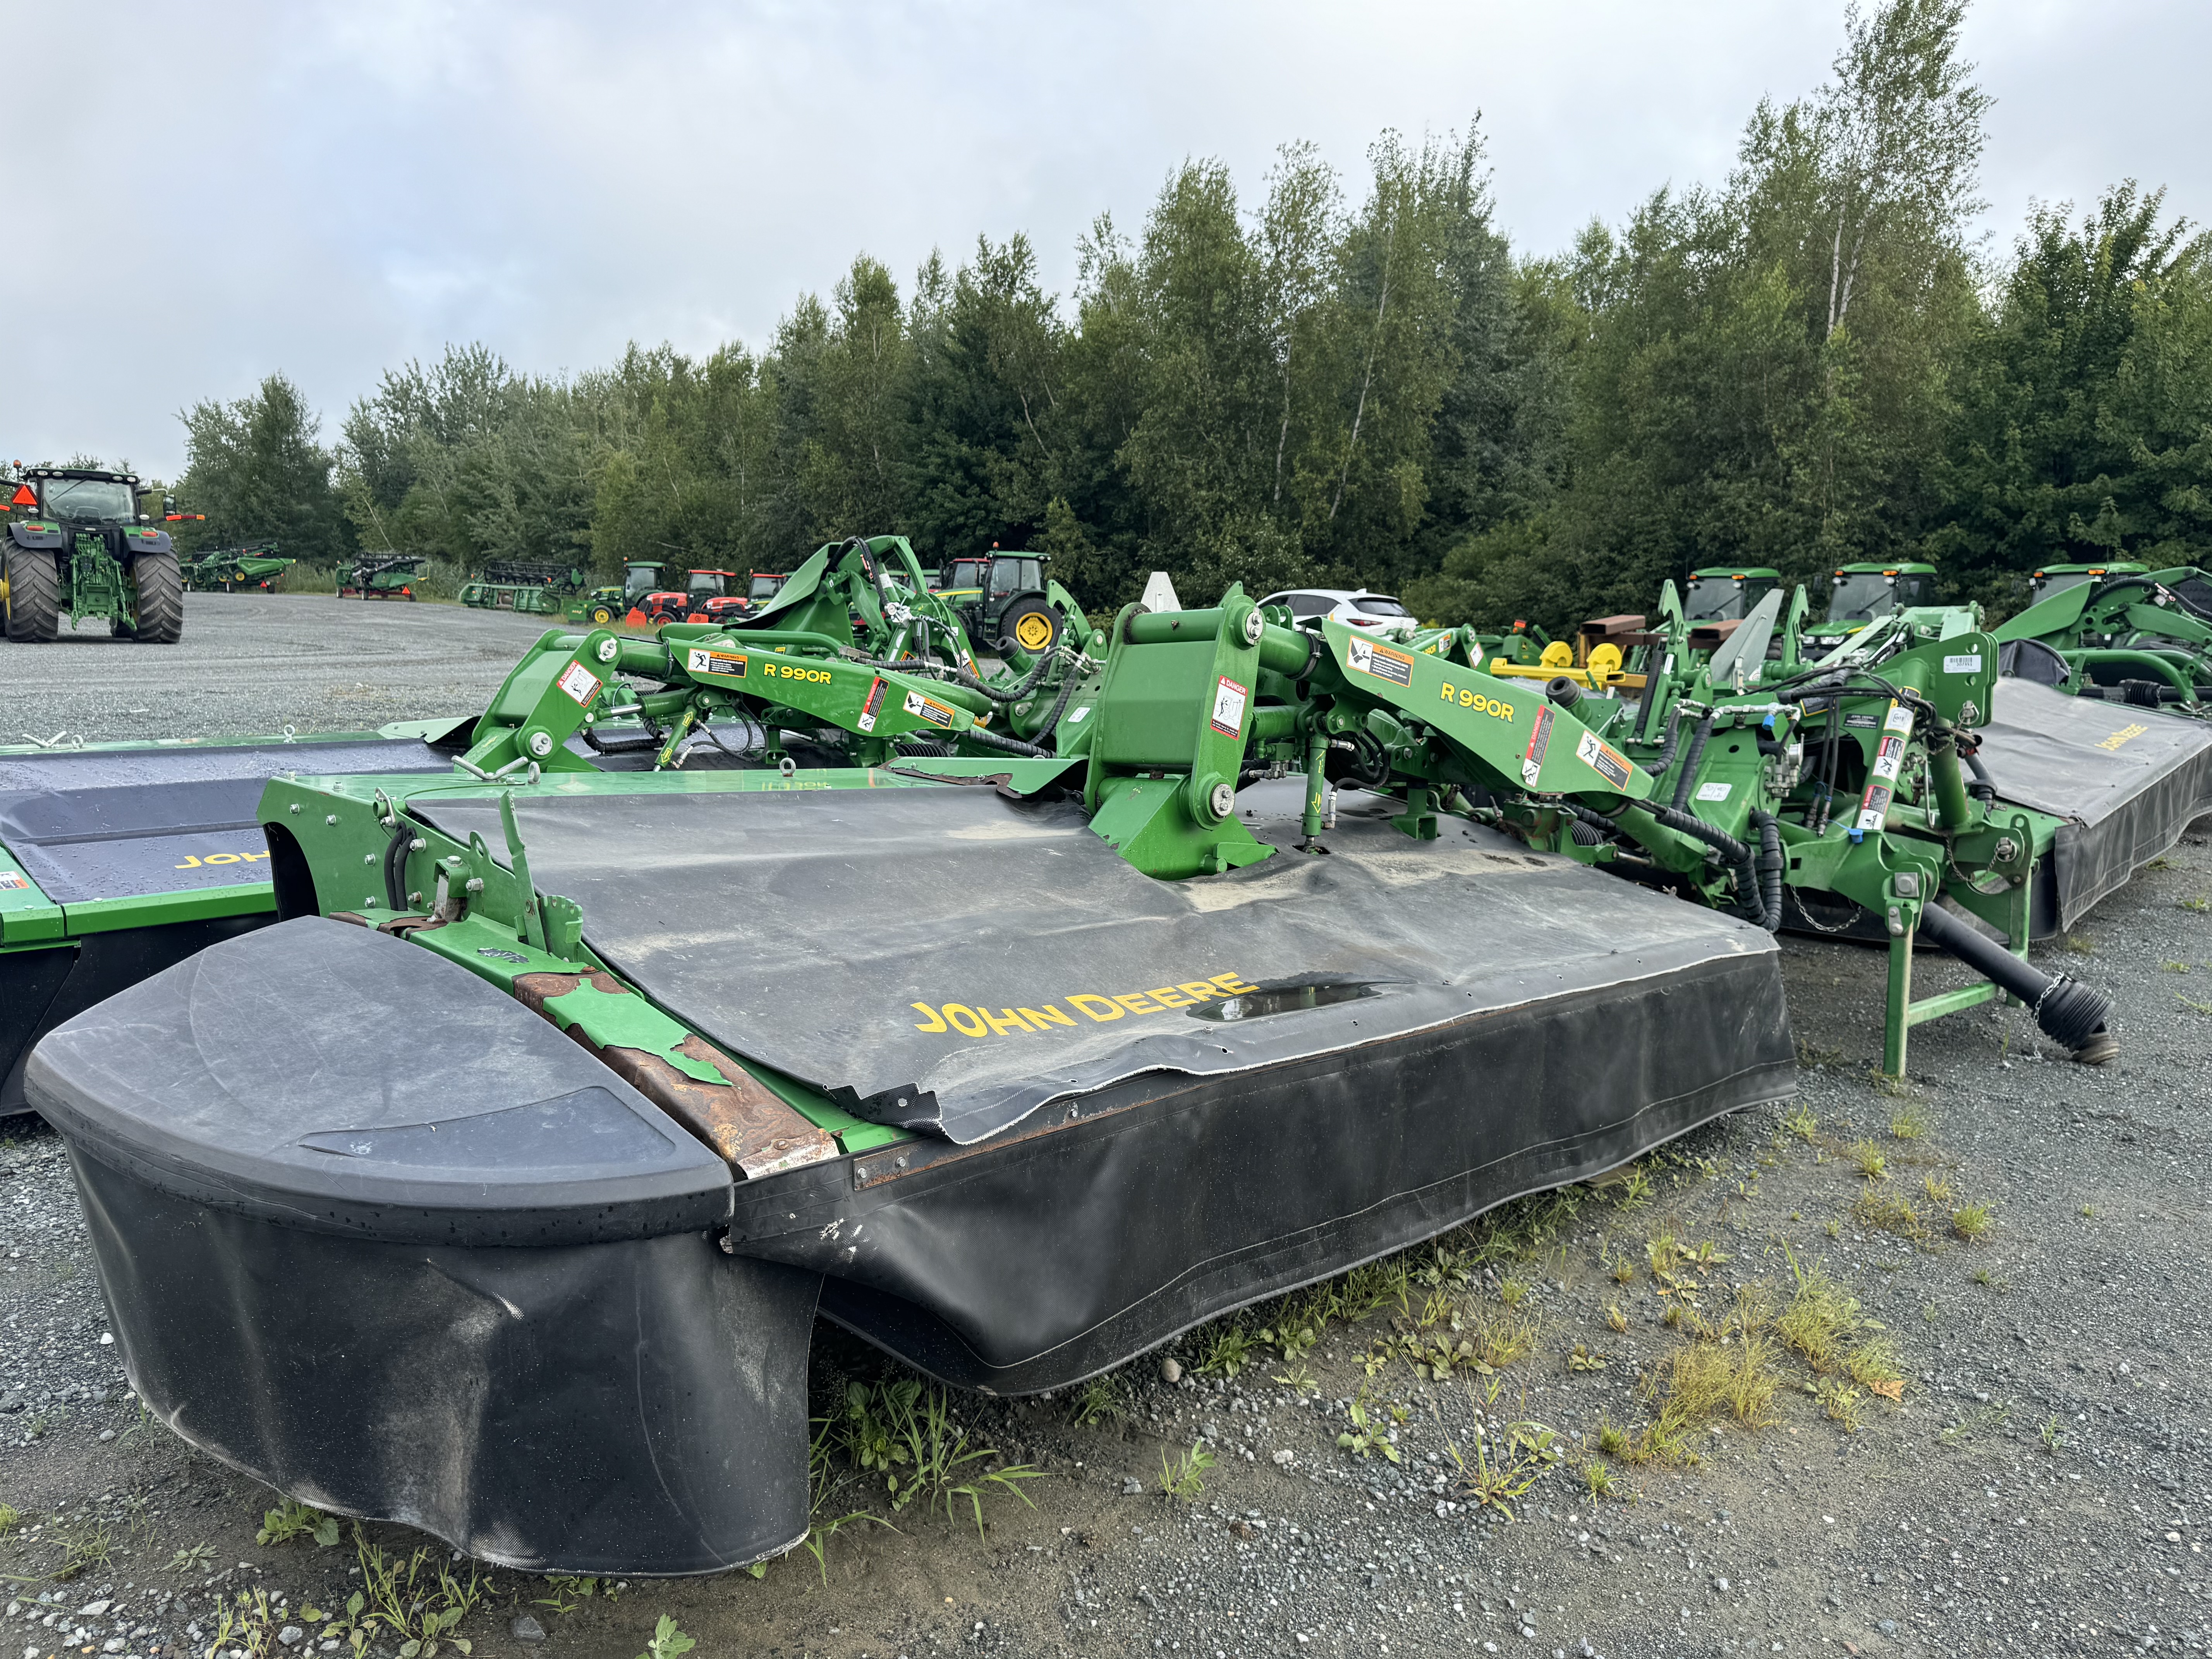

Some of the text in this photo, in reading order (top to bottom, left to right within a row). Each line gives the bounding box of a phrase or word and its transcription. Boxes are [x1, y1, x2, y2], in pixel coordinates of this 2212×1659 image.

[1384, 649, 1405, 660] WARNING
[561, 661, 577, 681] DANGER
[764, 663, 832, 684] R 990R
[1226, 680, 1246, 694] DANGER
[1441, 682, 1514, 723] R 990R
[1531, 715, 1542, 740] DANGER
[175, 850, 270, 869] JOH
[910, 972, 1261, 1037] JOHN DEERE
